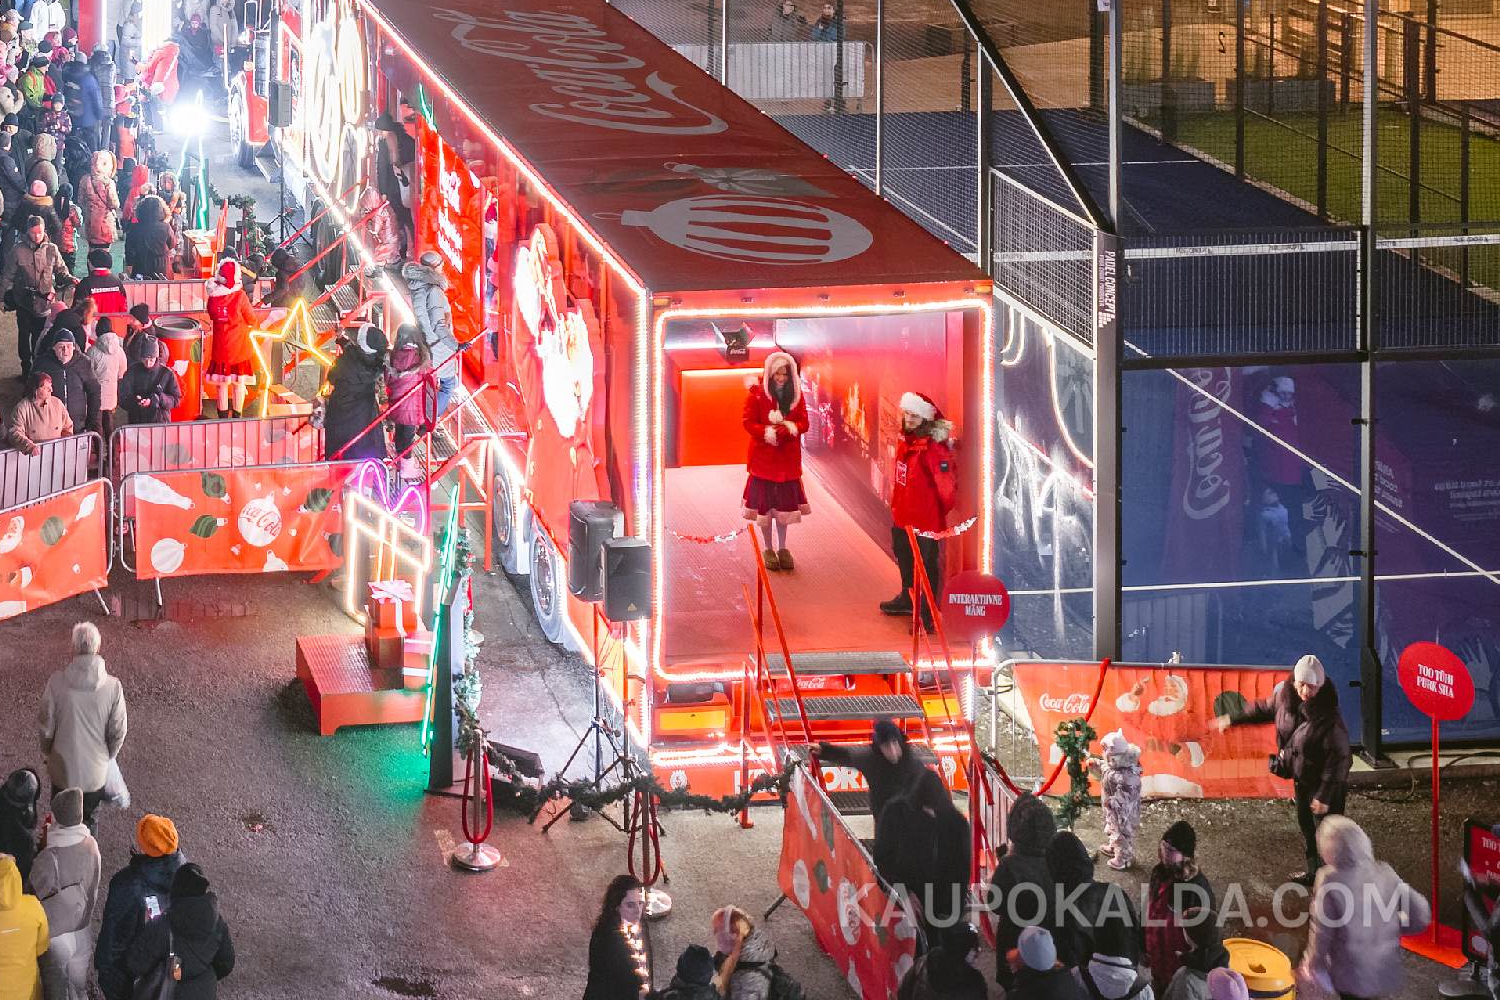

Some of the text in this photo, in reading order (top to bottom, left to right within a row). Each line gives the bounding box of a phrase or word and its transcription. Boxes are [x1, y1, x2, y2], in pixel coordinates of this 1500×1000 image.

[1104, 250, 1116, 314] PADEL CONCEPT
[948, 594, 1003, 605] INTERAKTIIVNE
[965, 604, 986, 616] MÄNG
[1418, 663, 1434, 679] TOO
[1417, 676, 1455, 699] PURK SIIA
[1039, 692, 1090, 714] Coca-Cola
